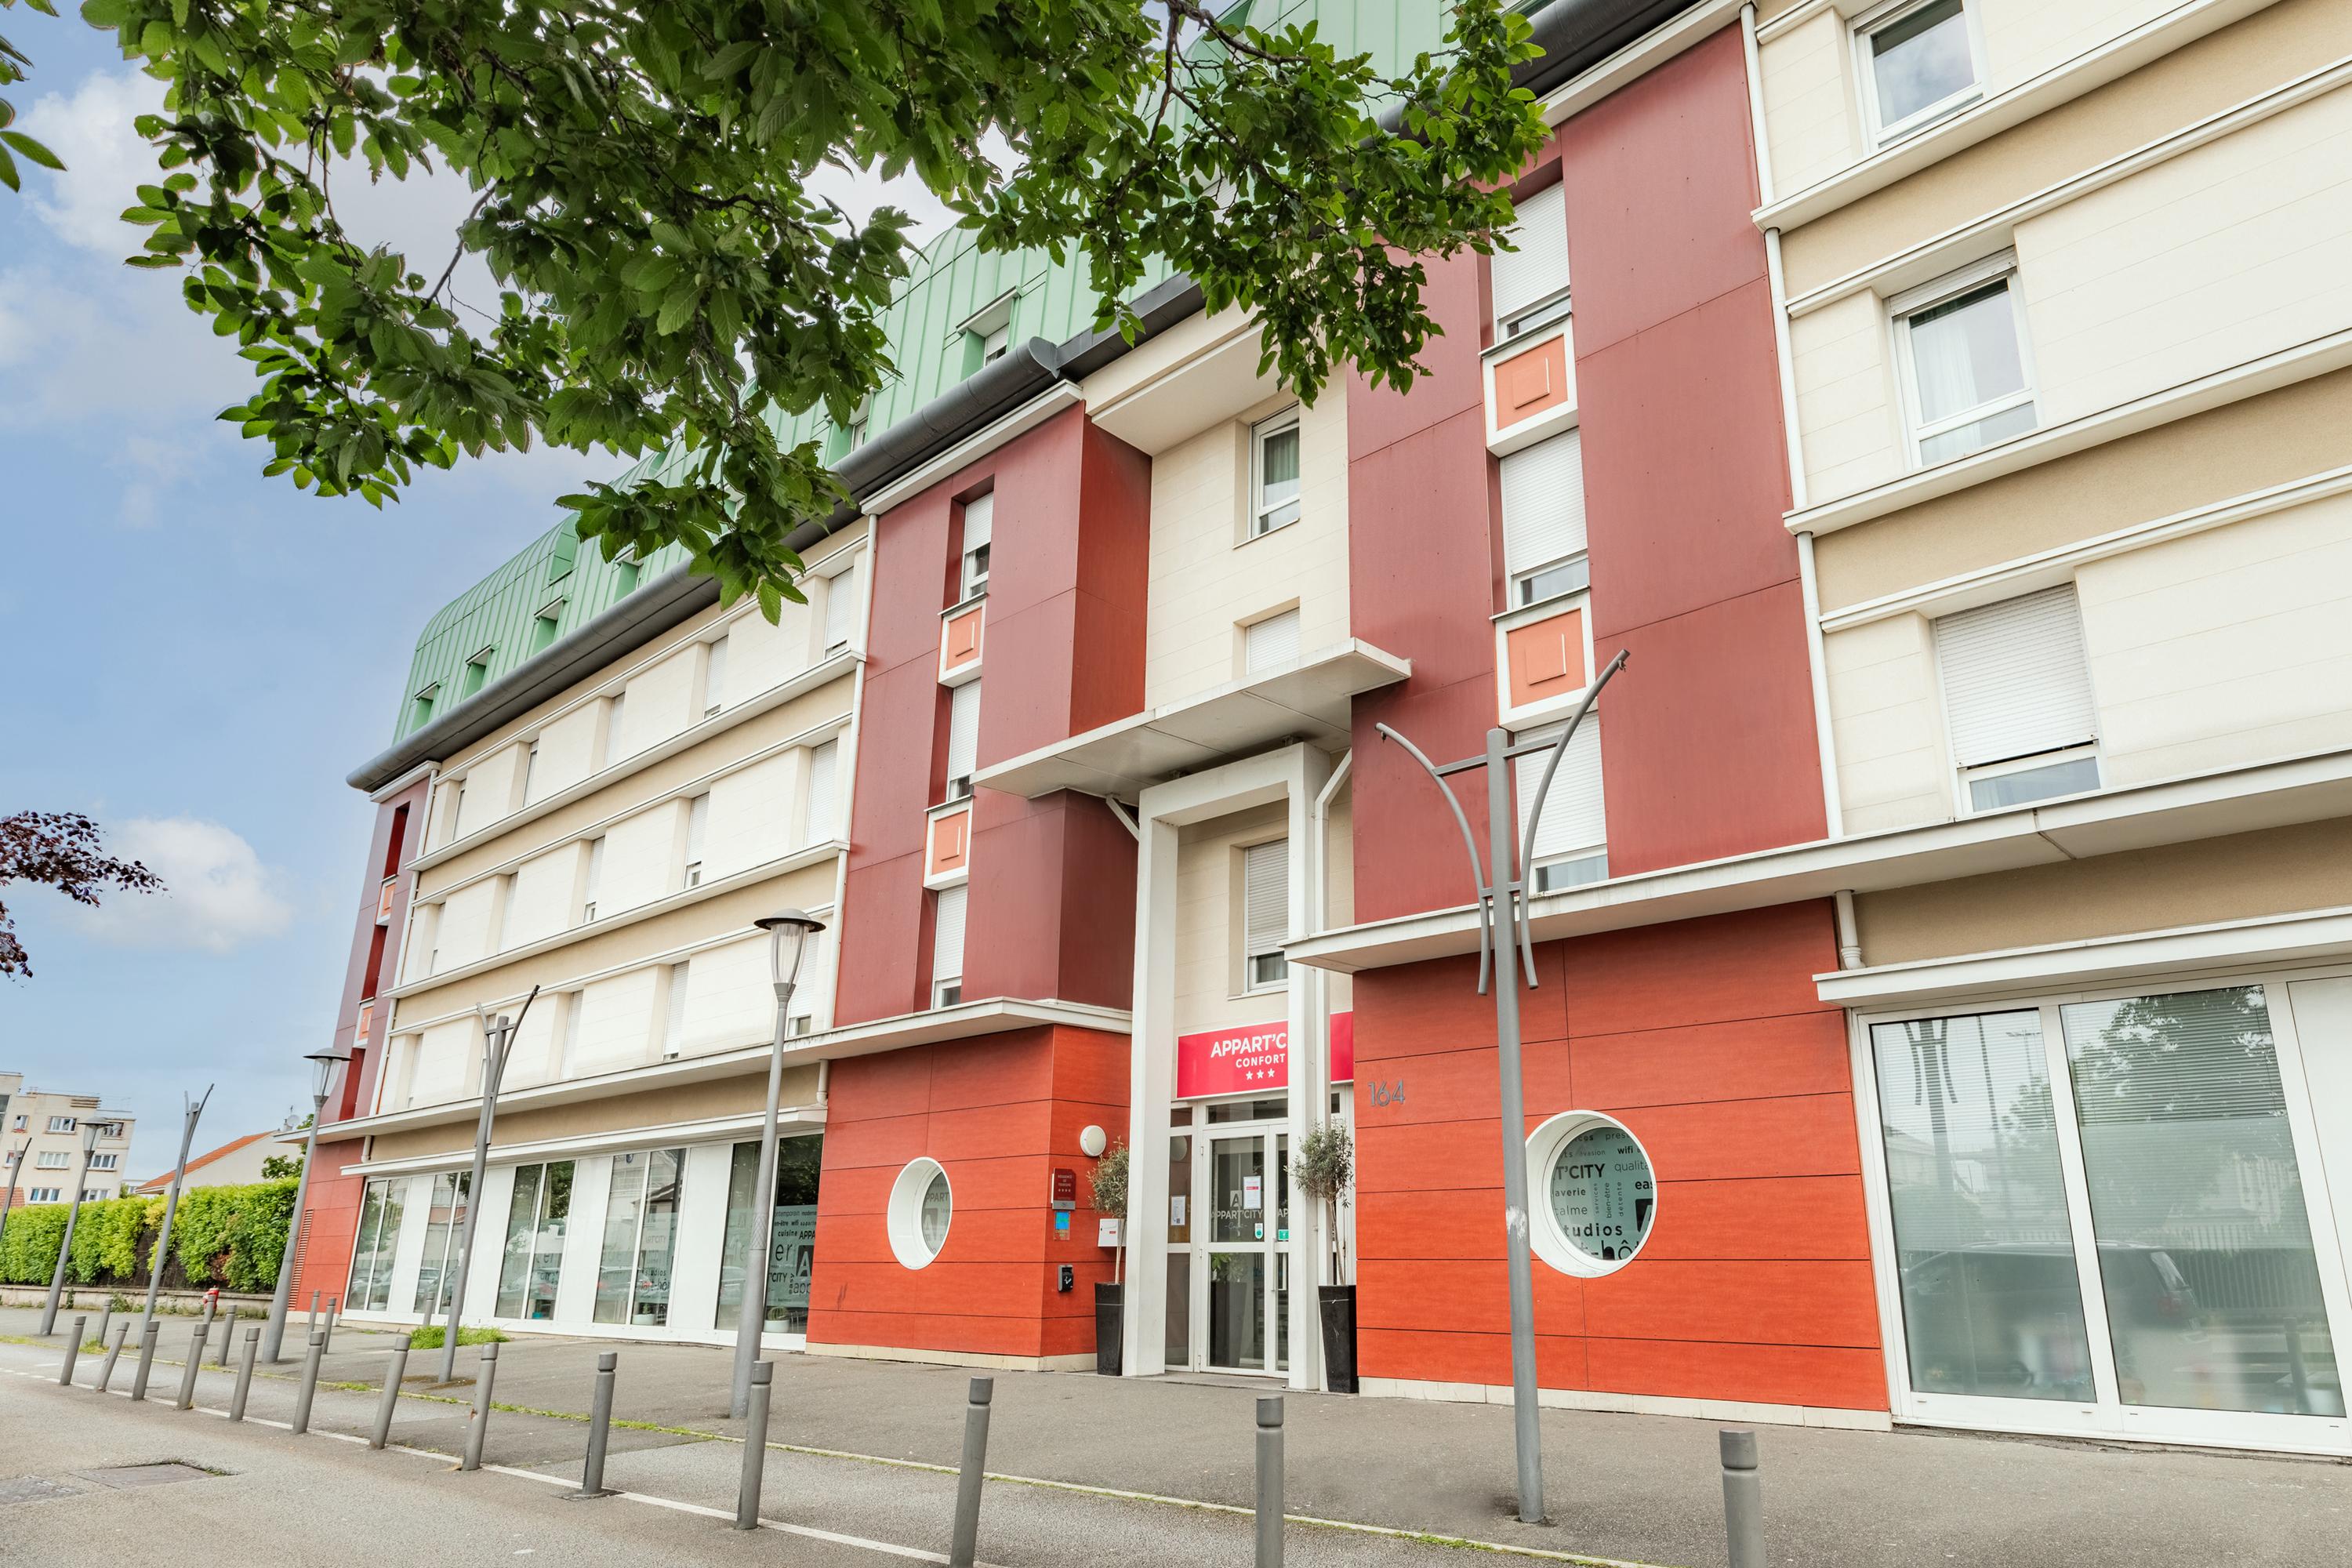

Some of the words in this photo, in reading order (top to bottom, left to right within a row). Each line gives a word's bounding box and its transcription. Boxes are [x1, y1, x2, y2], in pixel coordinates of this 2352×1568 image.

[1236, 1054, 1286, 1069] CONFORT
[1367, 1079, 1405, 1107] 164
[1617, 1145, 1633, 1154] wifi
